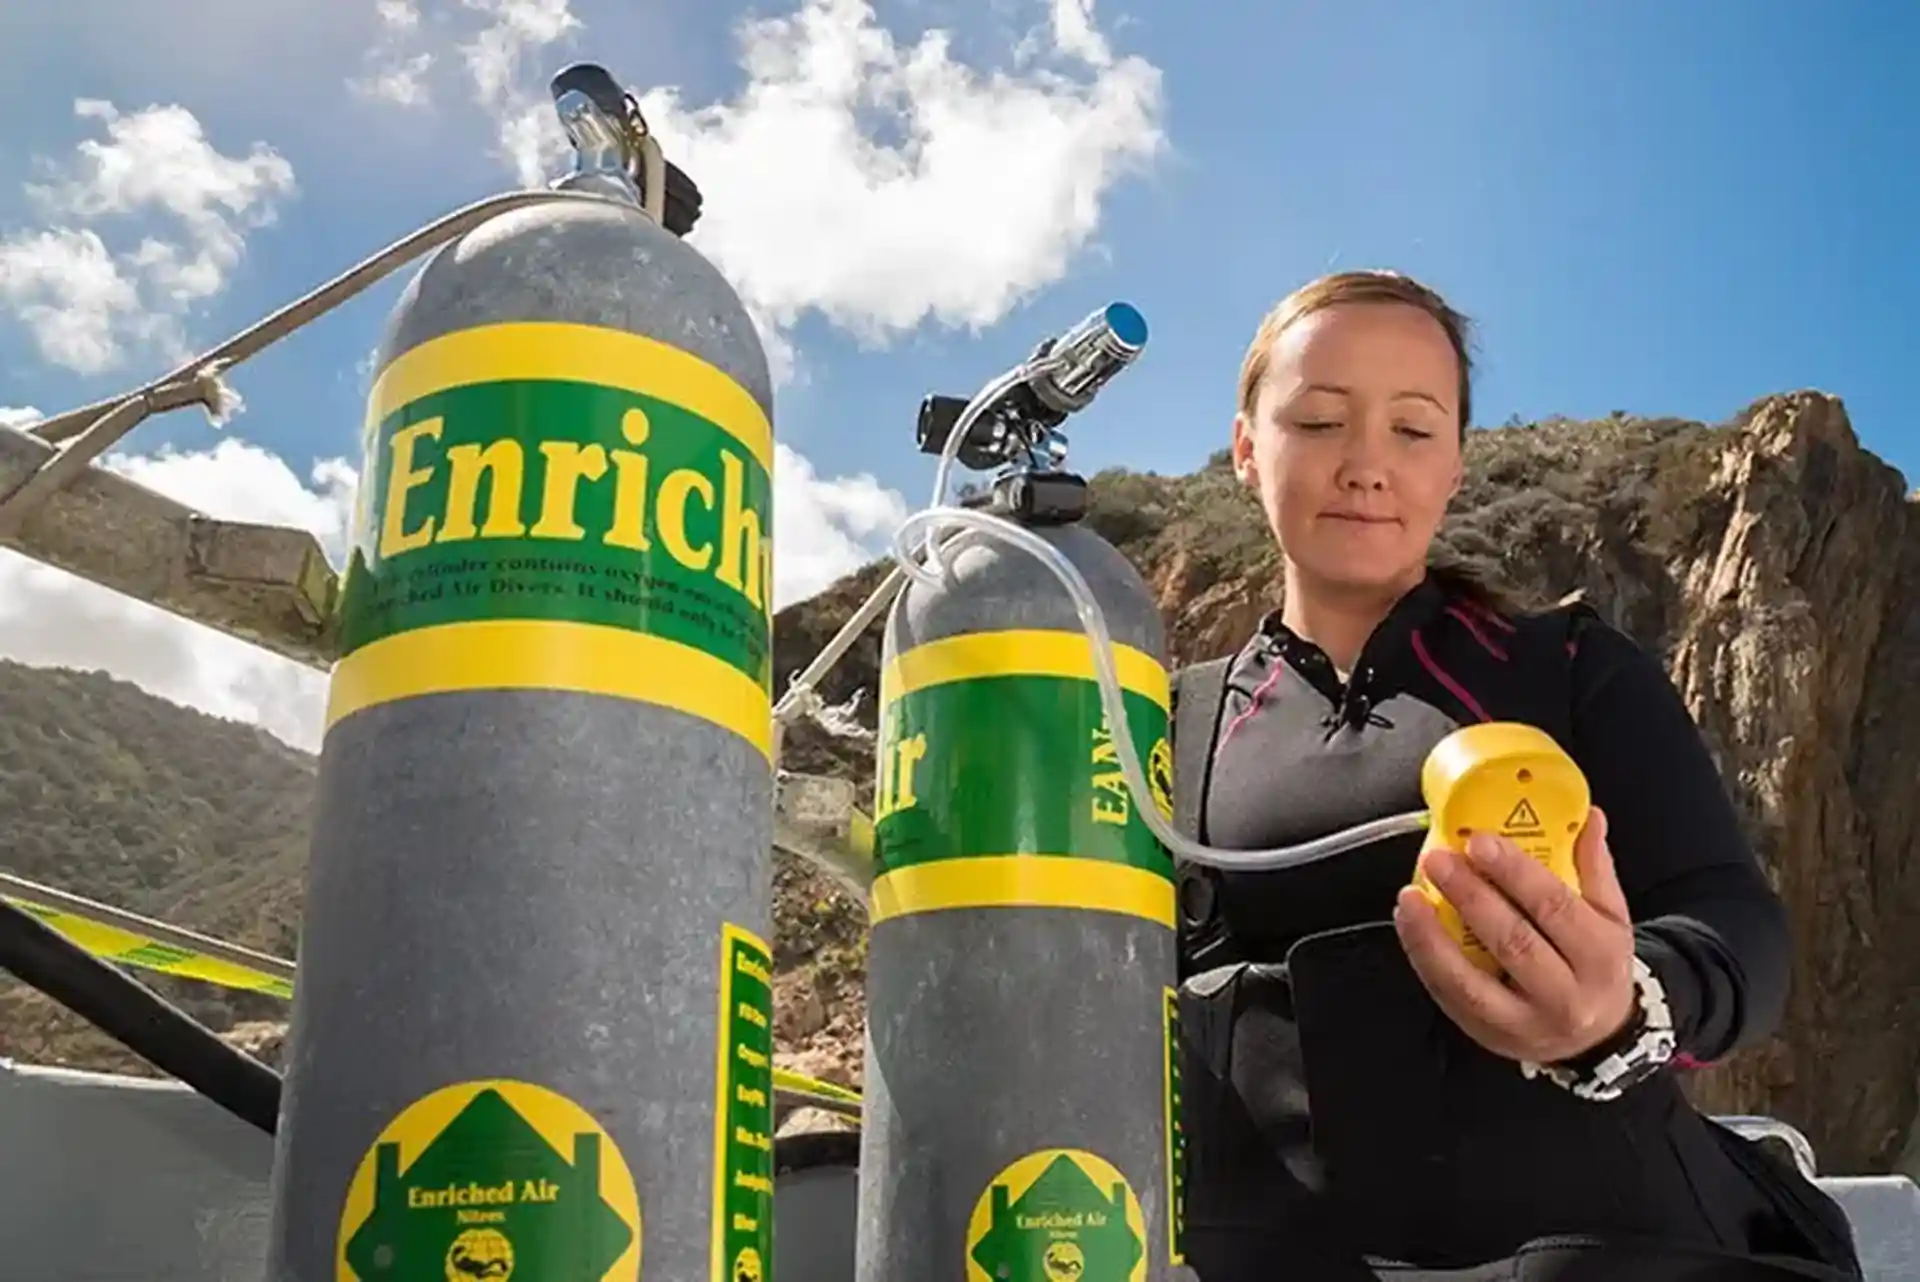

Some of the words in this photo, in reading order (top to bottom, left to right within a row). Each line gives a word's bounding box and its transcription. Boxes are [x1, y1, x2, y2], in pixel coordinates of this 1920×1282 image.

[380, 408, 772, 611] Enrich
[876, 712, 926, 824] ir
[1091, 709, 1128, 826] EAN
[408, 1179, 514, 1208] Enriched
[520, 1176, 560, 1202] Air
